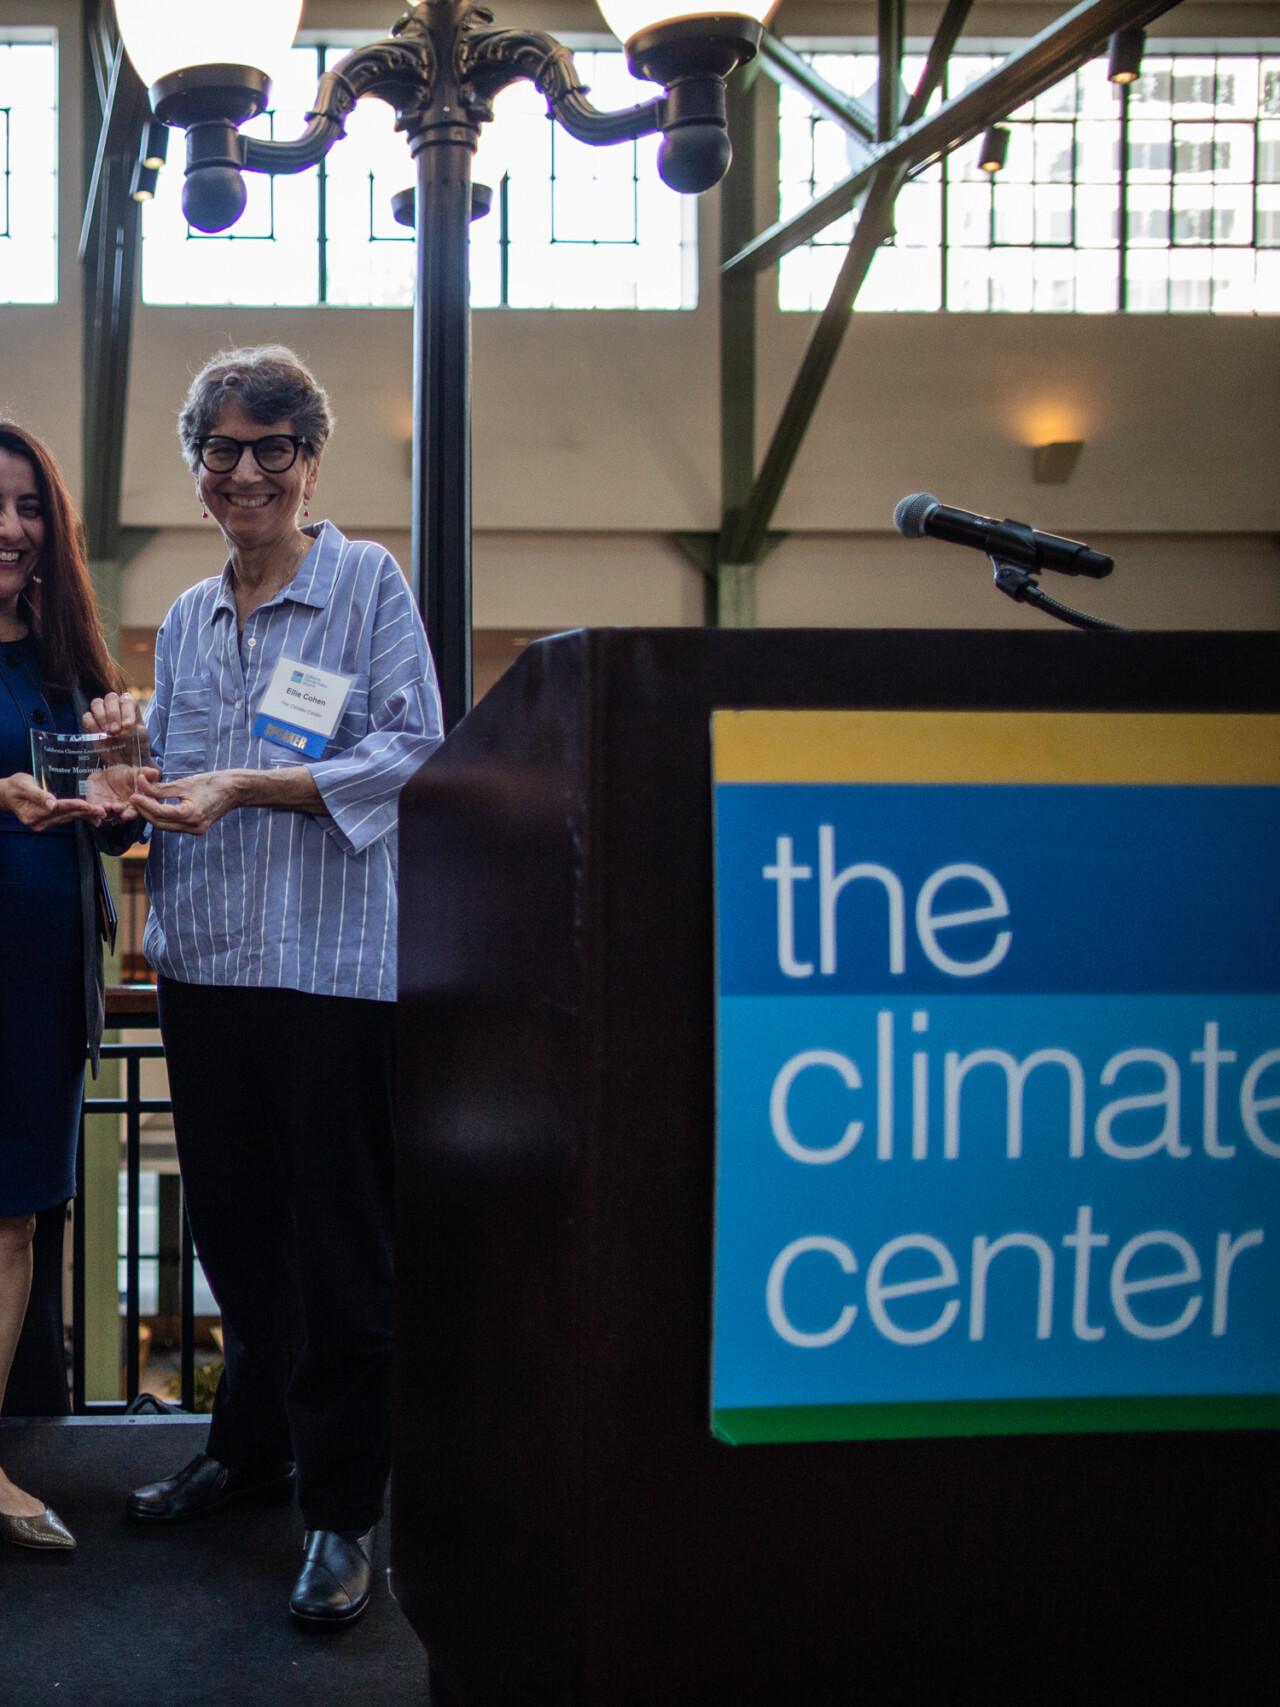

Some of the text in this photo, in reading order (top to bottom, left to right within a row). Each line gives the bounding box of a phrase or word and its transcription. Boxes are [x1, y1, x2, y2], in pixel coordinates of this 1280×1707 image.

[286, 687, 326, 706] Ellie Cohen
[762, 824, 1013, 978] the
[765, 1205, 1265, 1348] center
